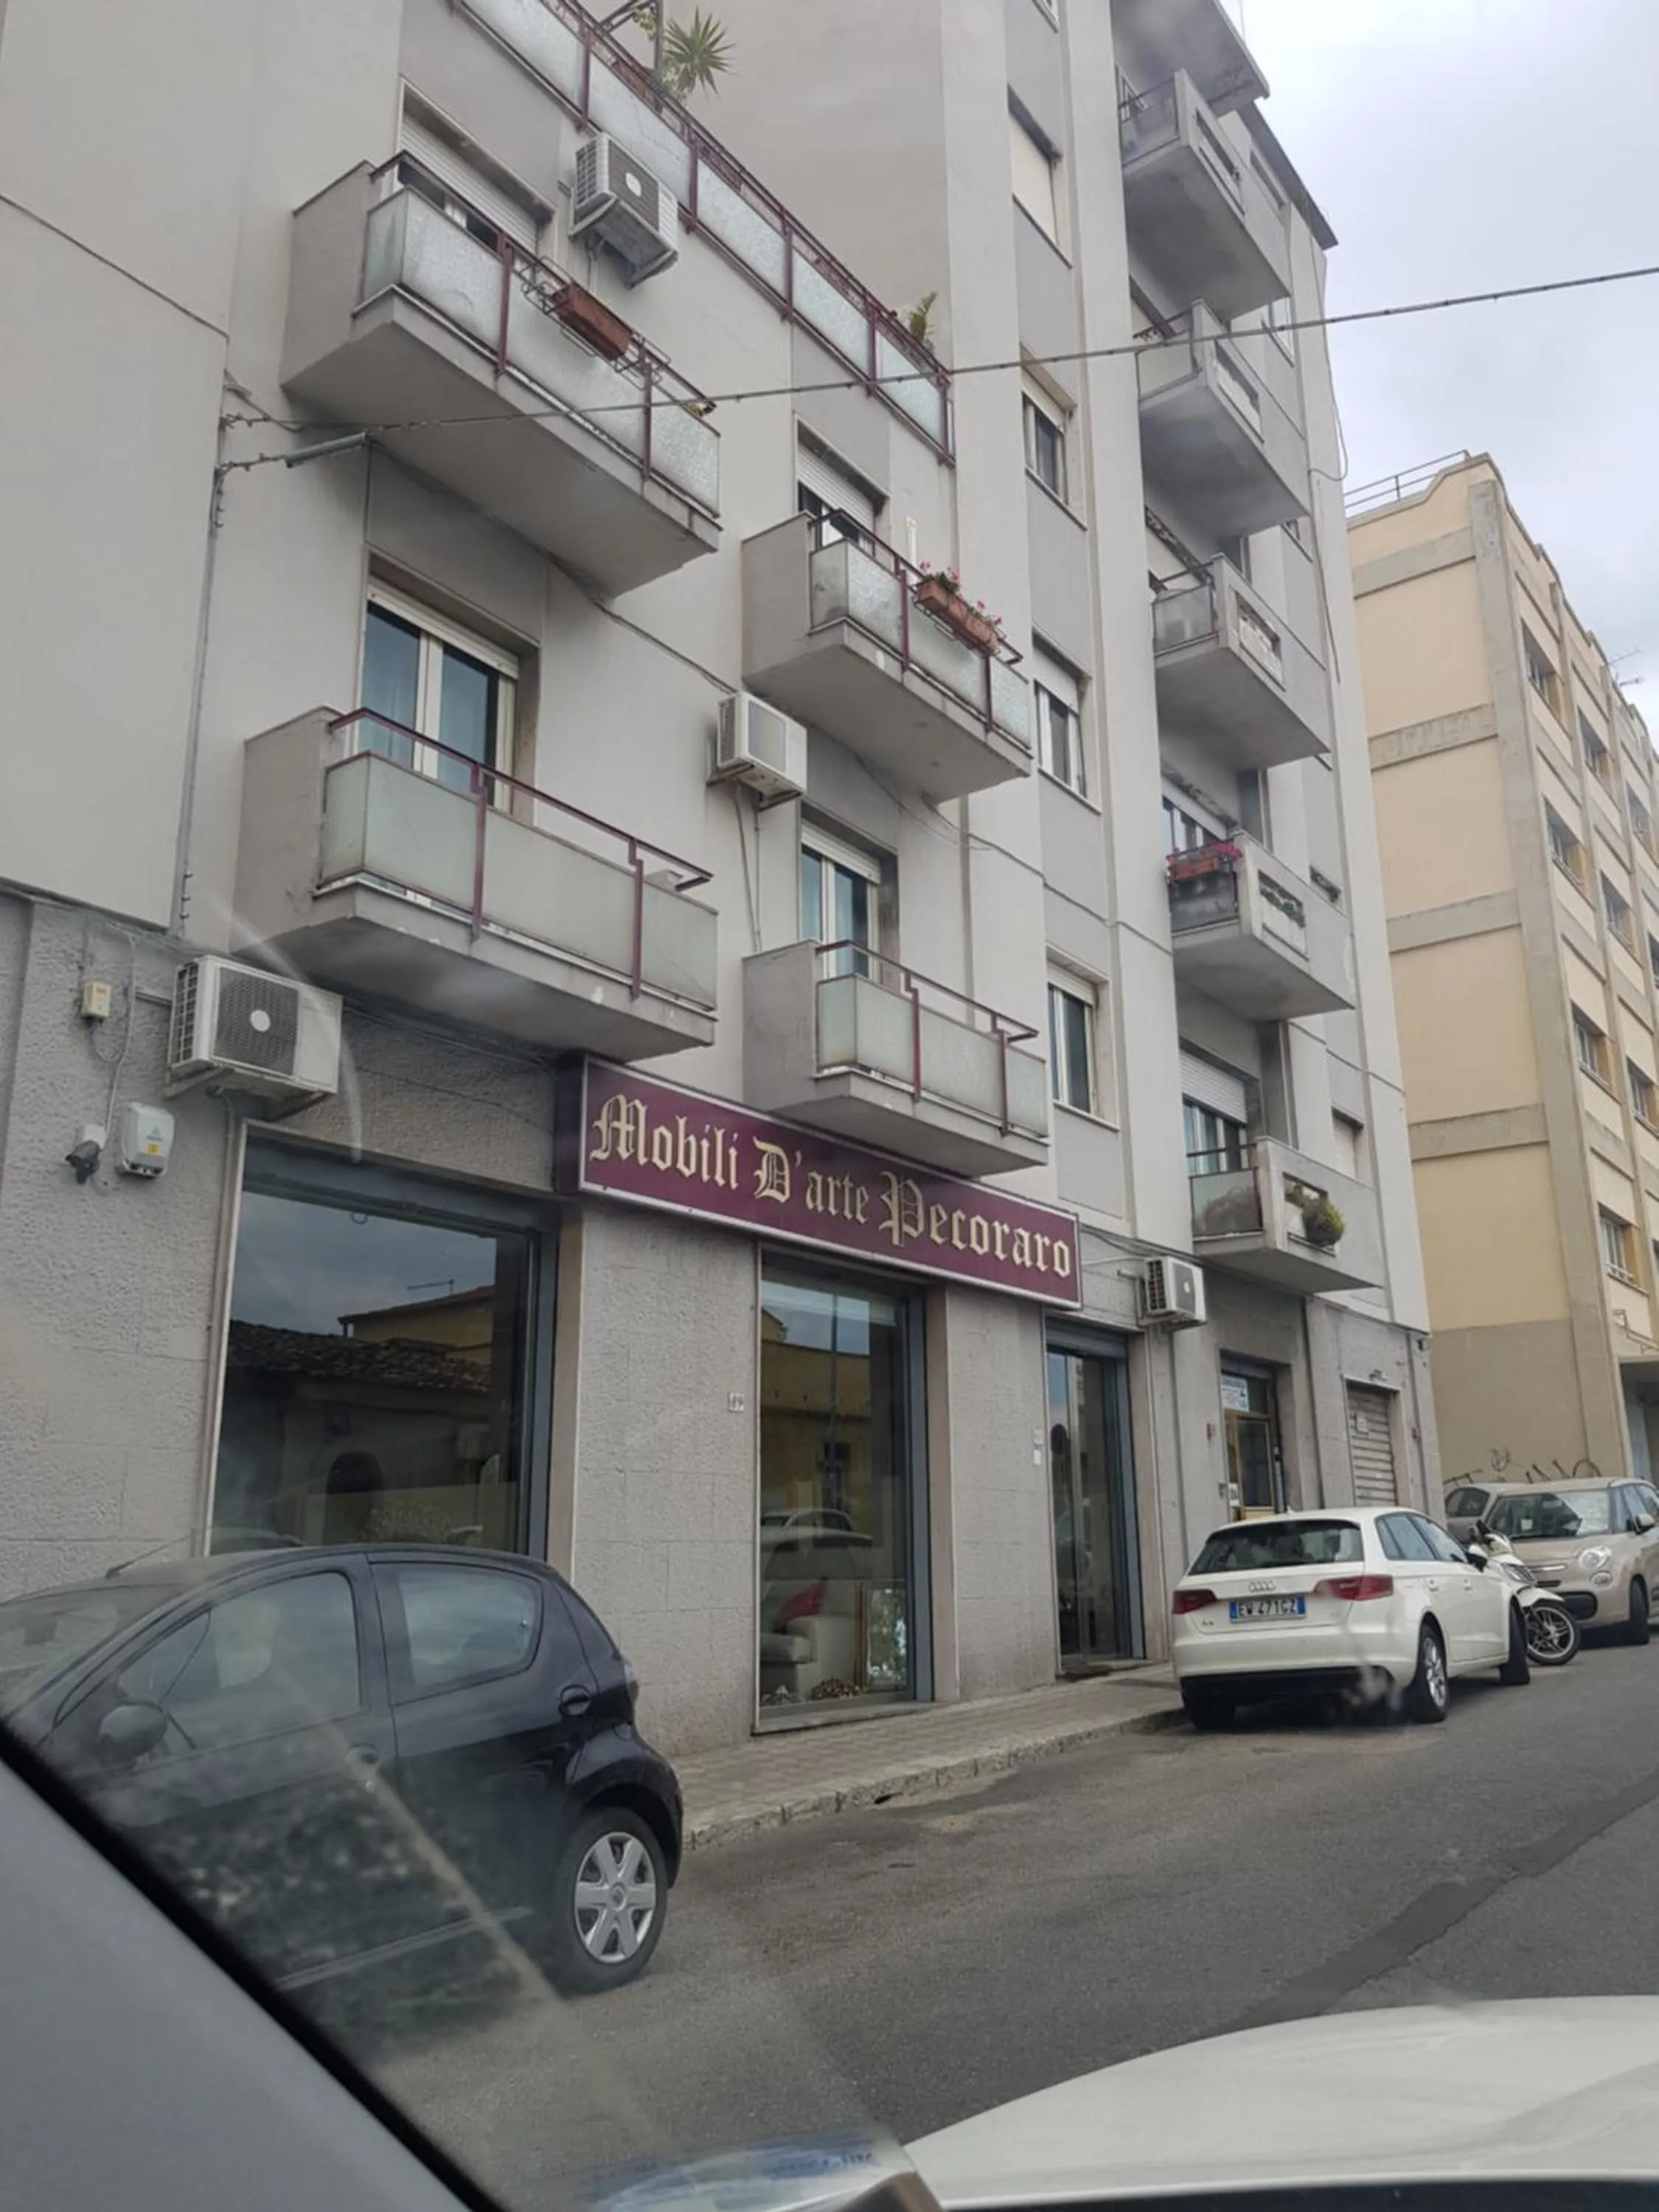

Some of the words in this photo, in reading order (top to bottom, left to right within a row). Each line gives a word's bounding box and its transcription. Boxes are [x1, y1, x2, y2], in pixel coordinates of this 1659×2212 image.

[589, 1093, 740, 1190] Mobili
[752, 1135, 870, 1224] D'arte
[877, 1170, 1071, 1279] Pecoraro
